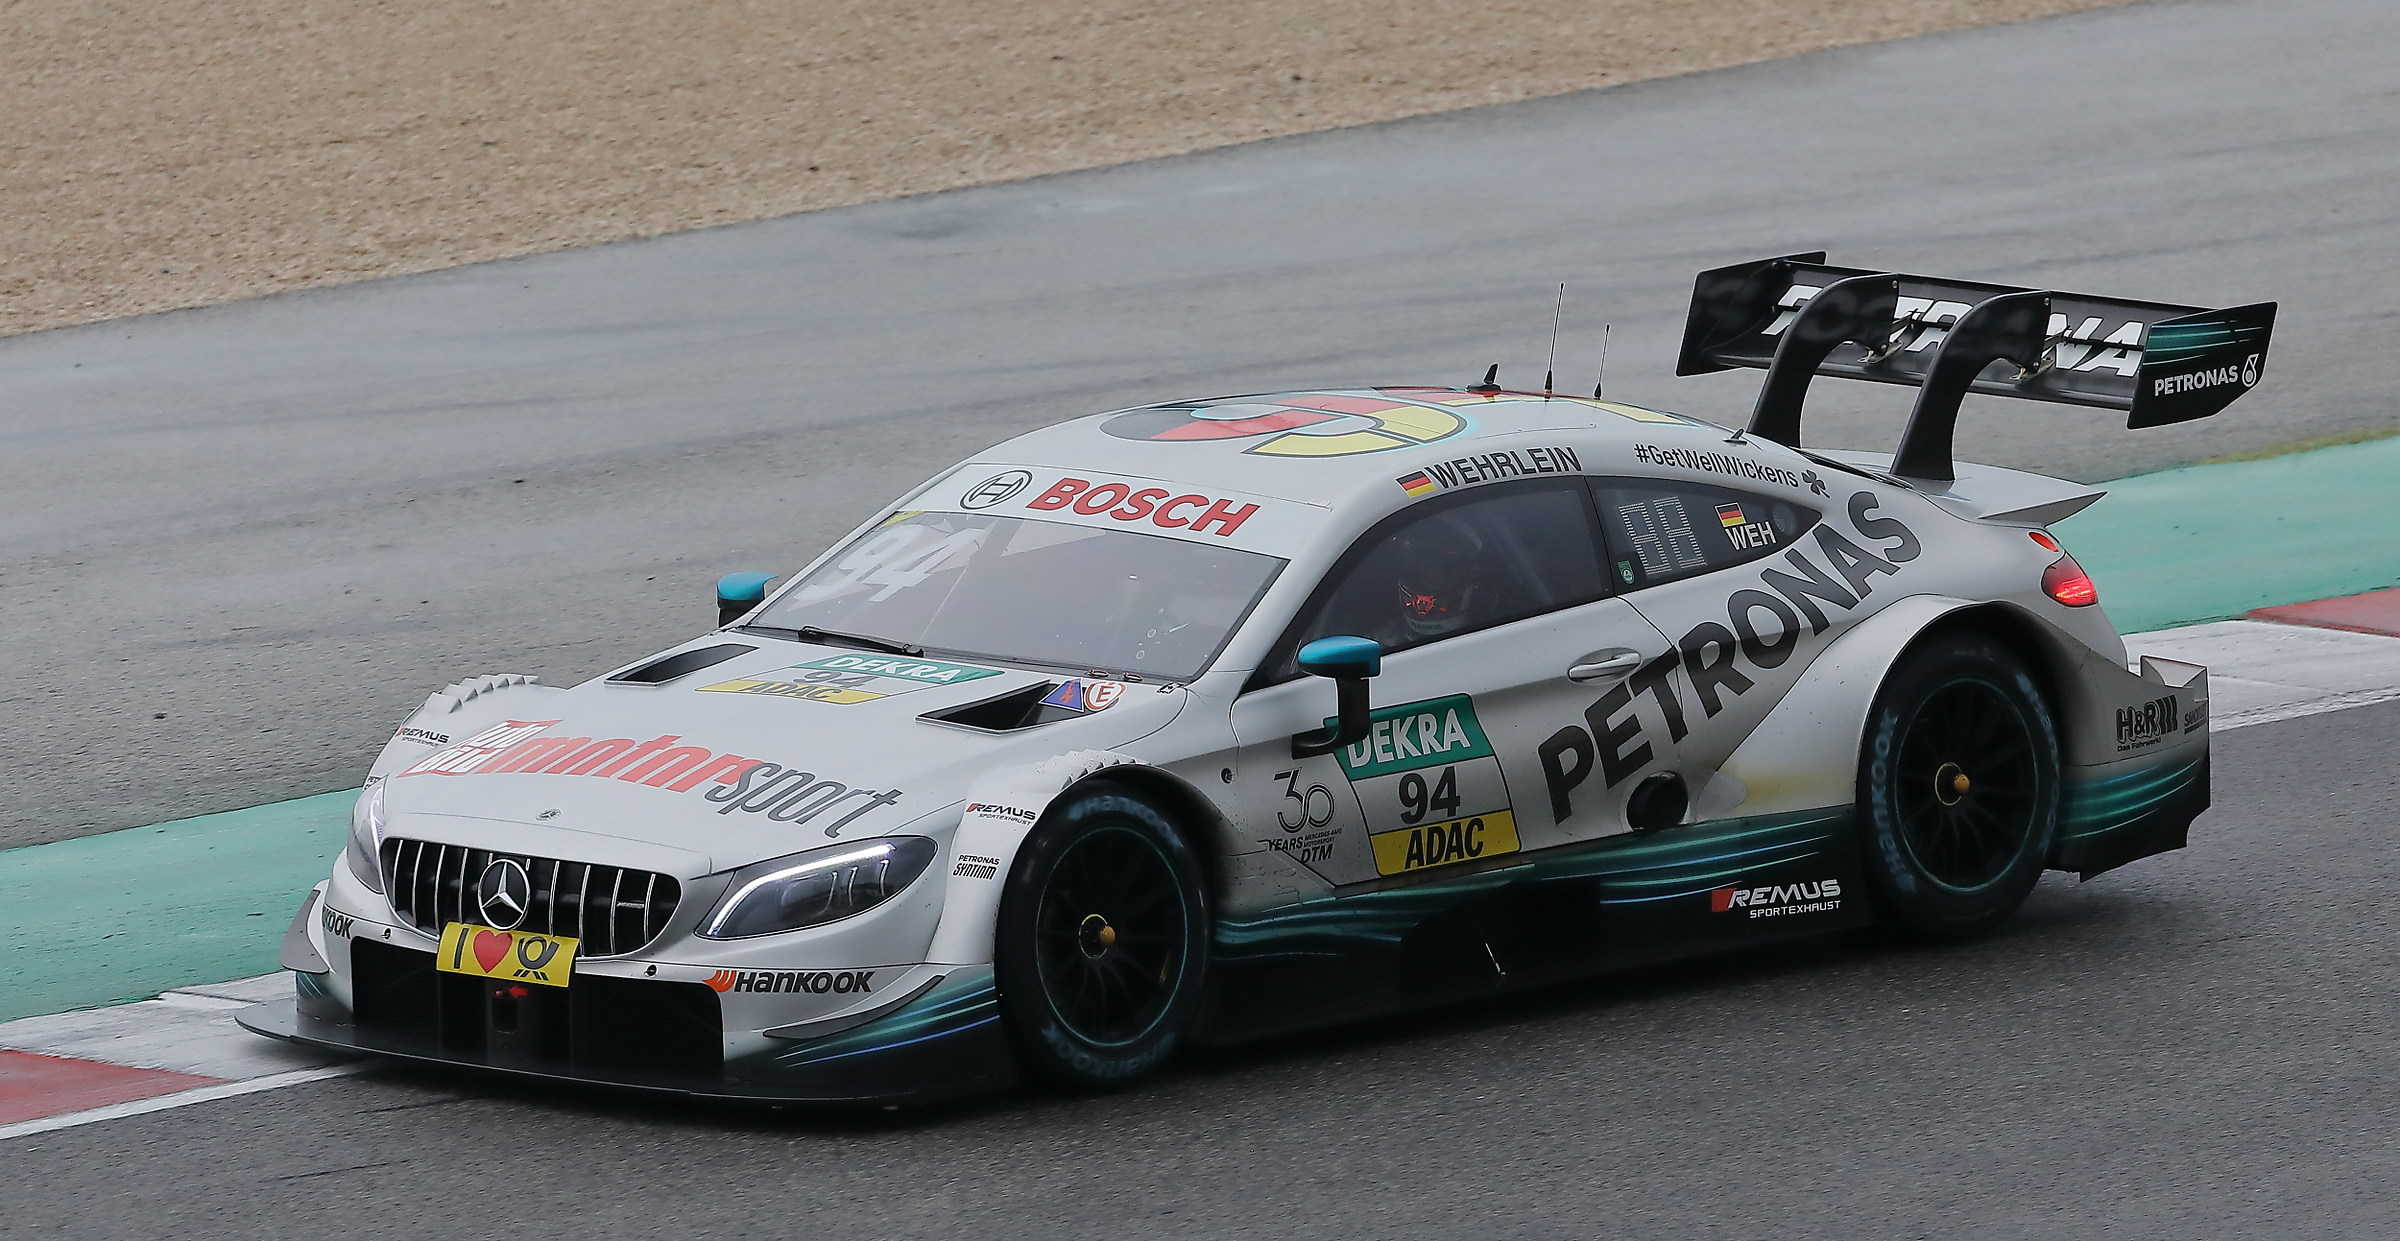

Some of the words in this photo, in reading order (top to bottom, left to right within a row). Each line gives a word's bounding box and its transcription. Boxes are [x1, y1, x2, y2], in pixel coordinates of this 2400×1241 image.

[2154, 365, 2239, 396] PETRONAS
[1424, 446, 1583, 490] WEHRLEIN
[1633, 443, 1799, 488] #GetWellWickens
[1025, 477, 1261, 537] BOSCH
[1725, 521, 1777, 551] WEH
[794, 524, 985, 602] 94
[820, 656, 963, 683] DEKRA
[1538, 490, 1922, 826] PETRONAS
[738, 681, 843, 700] ADAC
[793, 669, 881, 690] 94
[401, 727, 449, 743] REMUS
[2116, 701, 2161, 744] H&R
[1347, 708, 1471, 769] DEKRA
[474, 735, 903, 839] motorsport
[1273, 767, 1335, 834] 30
[1398, 766, 1461, 825] 94
[973, 803, 1036, 821] REMUS
[979, 813, 1031, 826] SPORTEXHAUST
[1257, 836, 1303, 852] YEARS
[1300, 843, 1334, 865] DTM
[1404, 817, 1485, 870] ADAC
[958, 855, 1000, 866] PETRONAS
[1728, 879, 1841, 909] REMUS
[1750, 900, 1841, 919] SPORTEXHAUST
[453, 928, 470, 969] I
